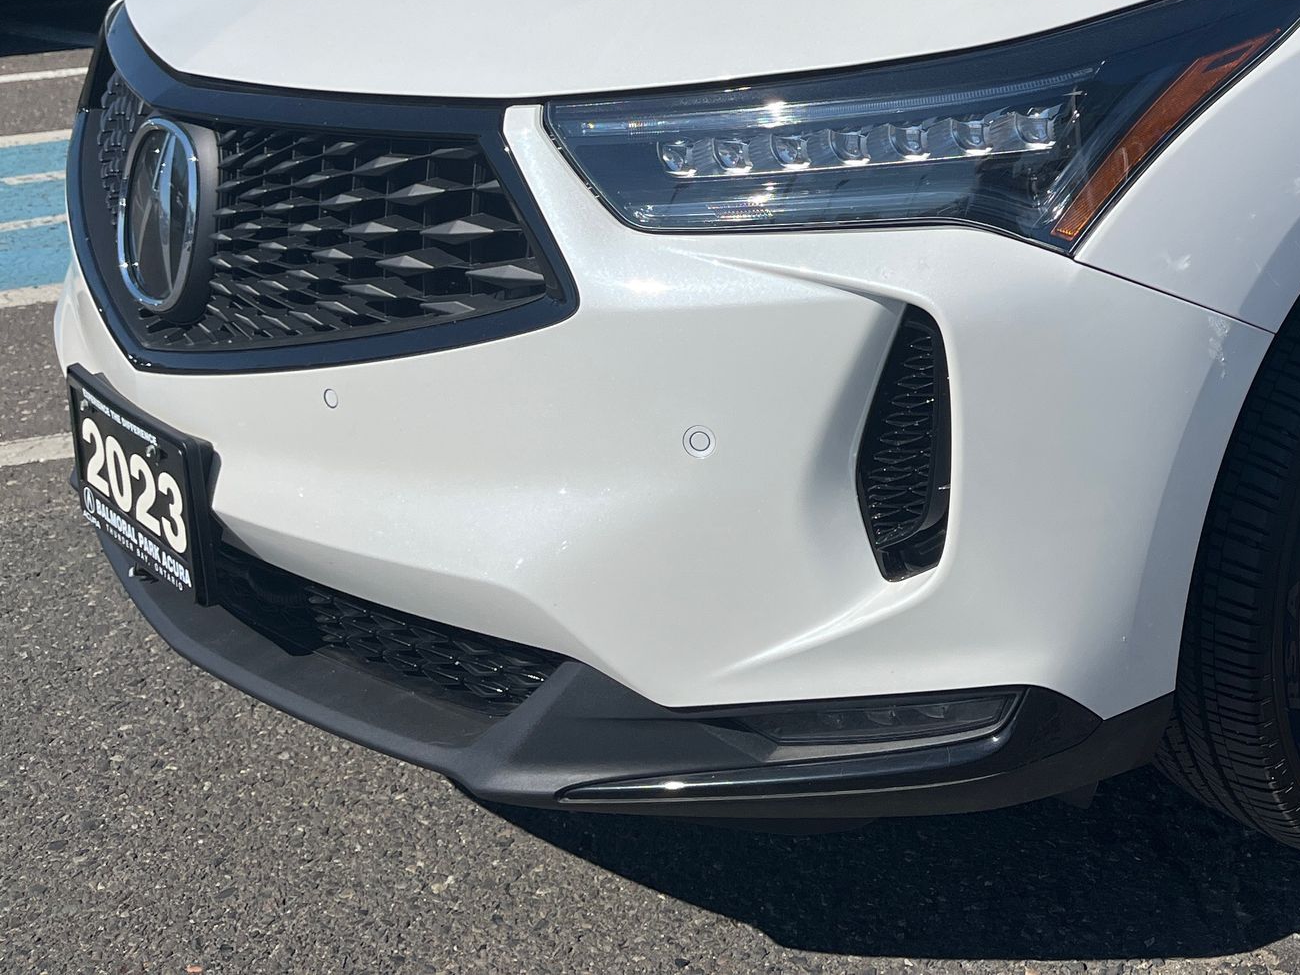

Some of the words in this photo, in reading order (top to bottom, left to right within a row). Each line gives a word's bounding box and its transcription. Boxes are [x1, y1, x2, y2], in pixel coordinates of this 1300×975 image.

[81, 417, 188, 554] 2023
[95, 498, 138, 545] BALMORAL
[137, 531, 162, 564] PARK
[161, 551, 192, 588] ACURA
